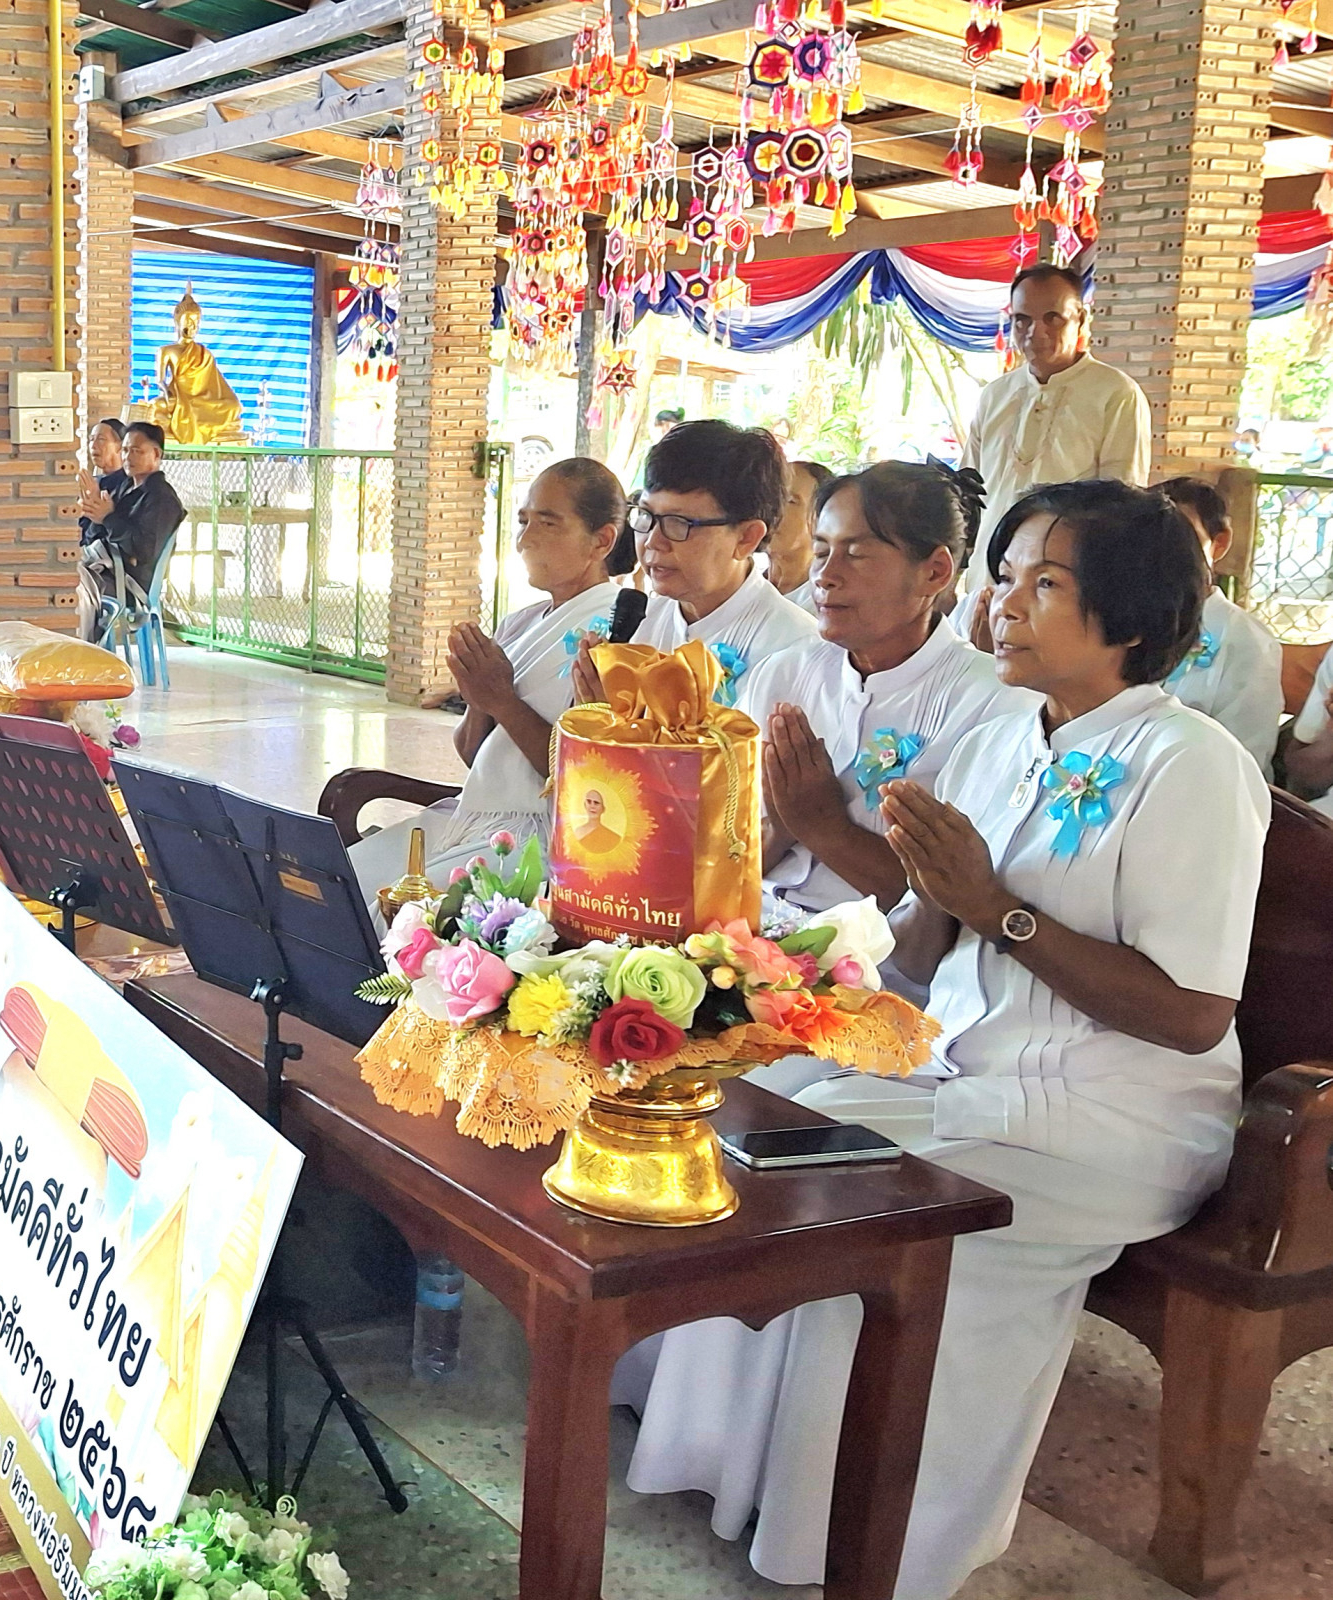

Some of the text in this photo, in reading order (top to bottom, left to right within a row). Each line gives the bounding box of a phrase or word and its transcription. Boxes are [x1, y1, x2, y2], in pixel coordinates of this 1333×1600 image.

[1, 1440, 14, 1475] ปี
[11, 1468, 88, 1600] หลวงพ่อธัมม
[59, 1378, 156, 1548] ๒๕๖๘
